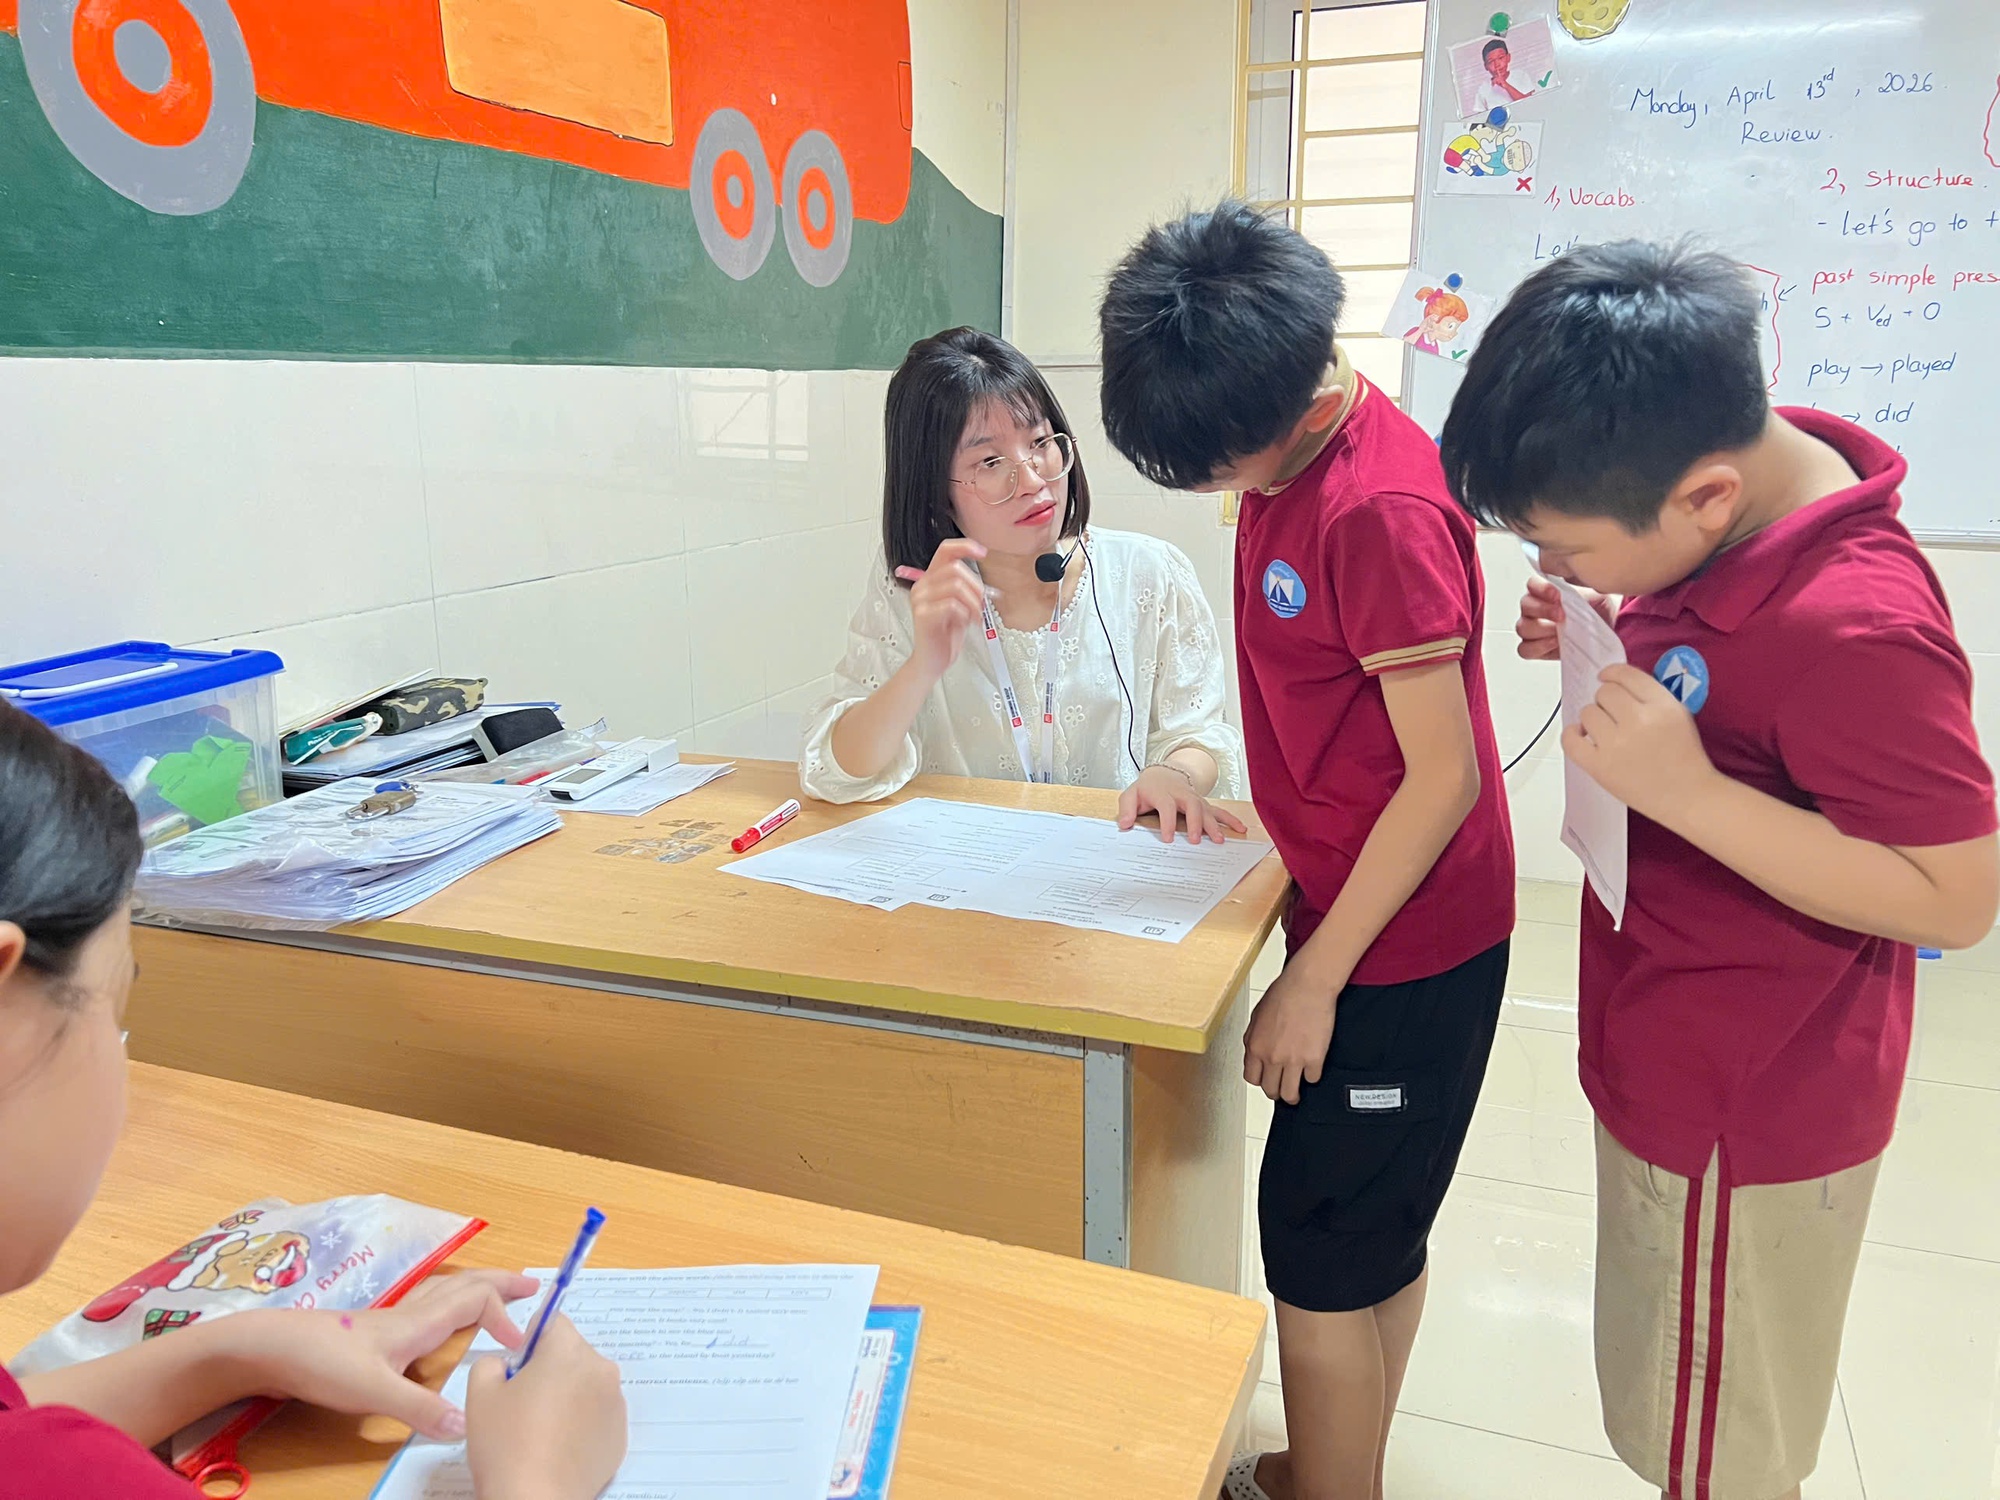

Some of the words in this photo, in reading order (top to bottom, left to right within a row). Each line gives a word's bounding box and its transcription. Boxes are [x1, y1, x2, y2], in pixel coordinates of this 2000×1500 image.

[1630, 87, 1708, 129] Monday,
[1726, 79, 1776, 115] April
[1908, 220, 1936, 247] go
[1948, 213, 1968, 232] to
[1811, 268, 1855, 295] past
[1868, 264, 1937, 294] simple
[1953, 270, 2000, 292] pres
[1814, 306, 1831, 329] S
[1807, 358, 1851, 387] play
[1890, 352, 1957, 384] played
[1874, 402, 1915, 423] did
[316, 1245, 374, 1291] Merry
